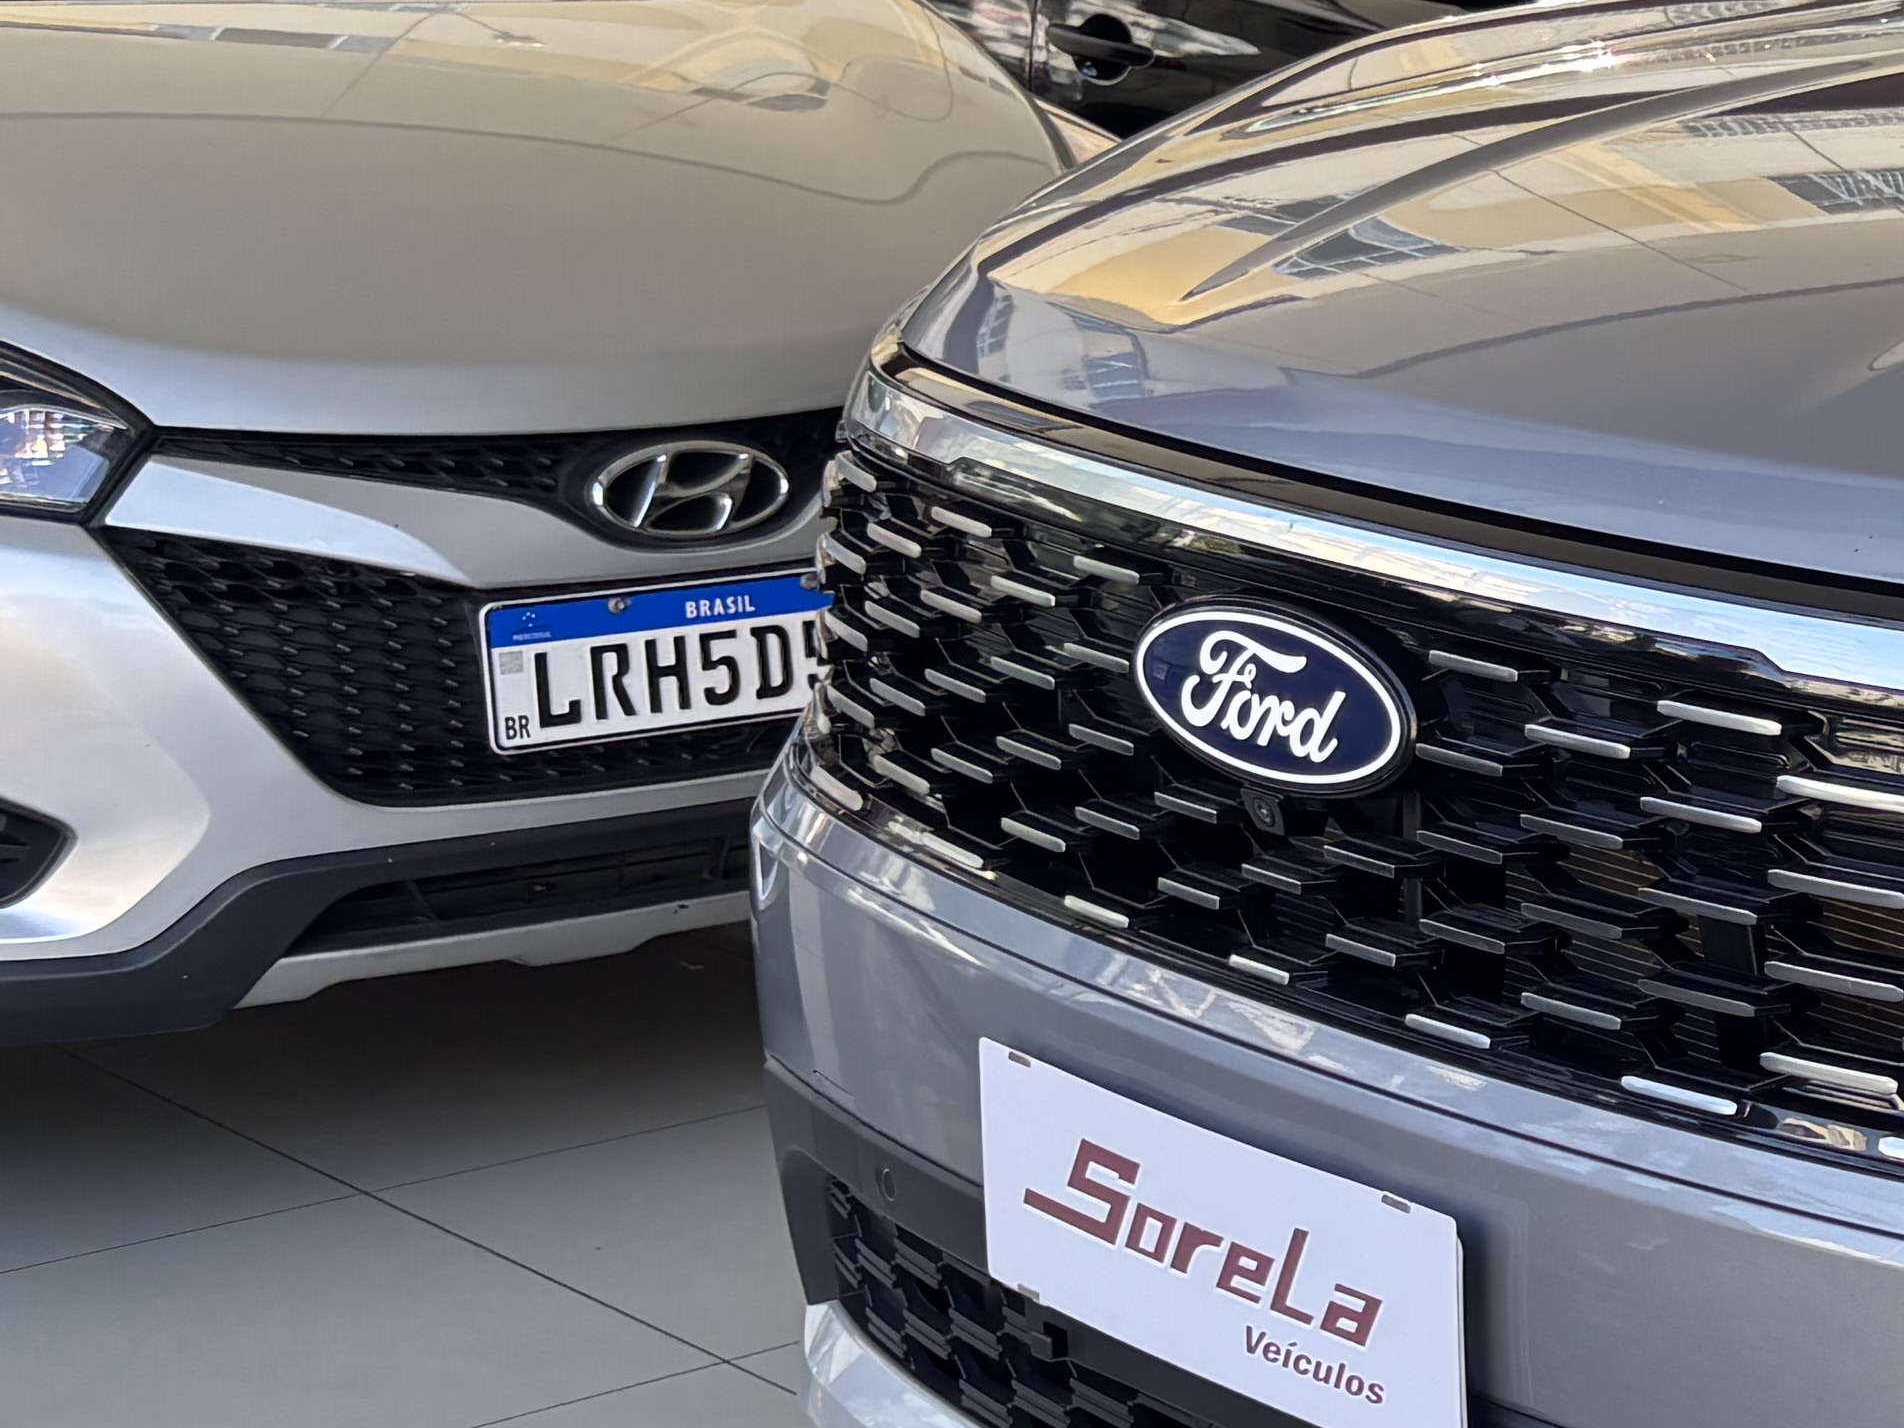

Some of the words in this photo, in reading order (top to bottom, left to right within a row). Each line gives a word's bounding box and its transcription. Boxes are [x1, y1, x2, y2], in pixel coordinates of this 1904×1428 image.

[685, 595, 756, 618] BRASIL
[1181, 630, 1346, 763] Ford
[505, 715, 530, 740] BR
[1244, 1325, 1385, 1405] Veículos
